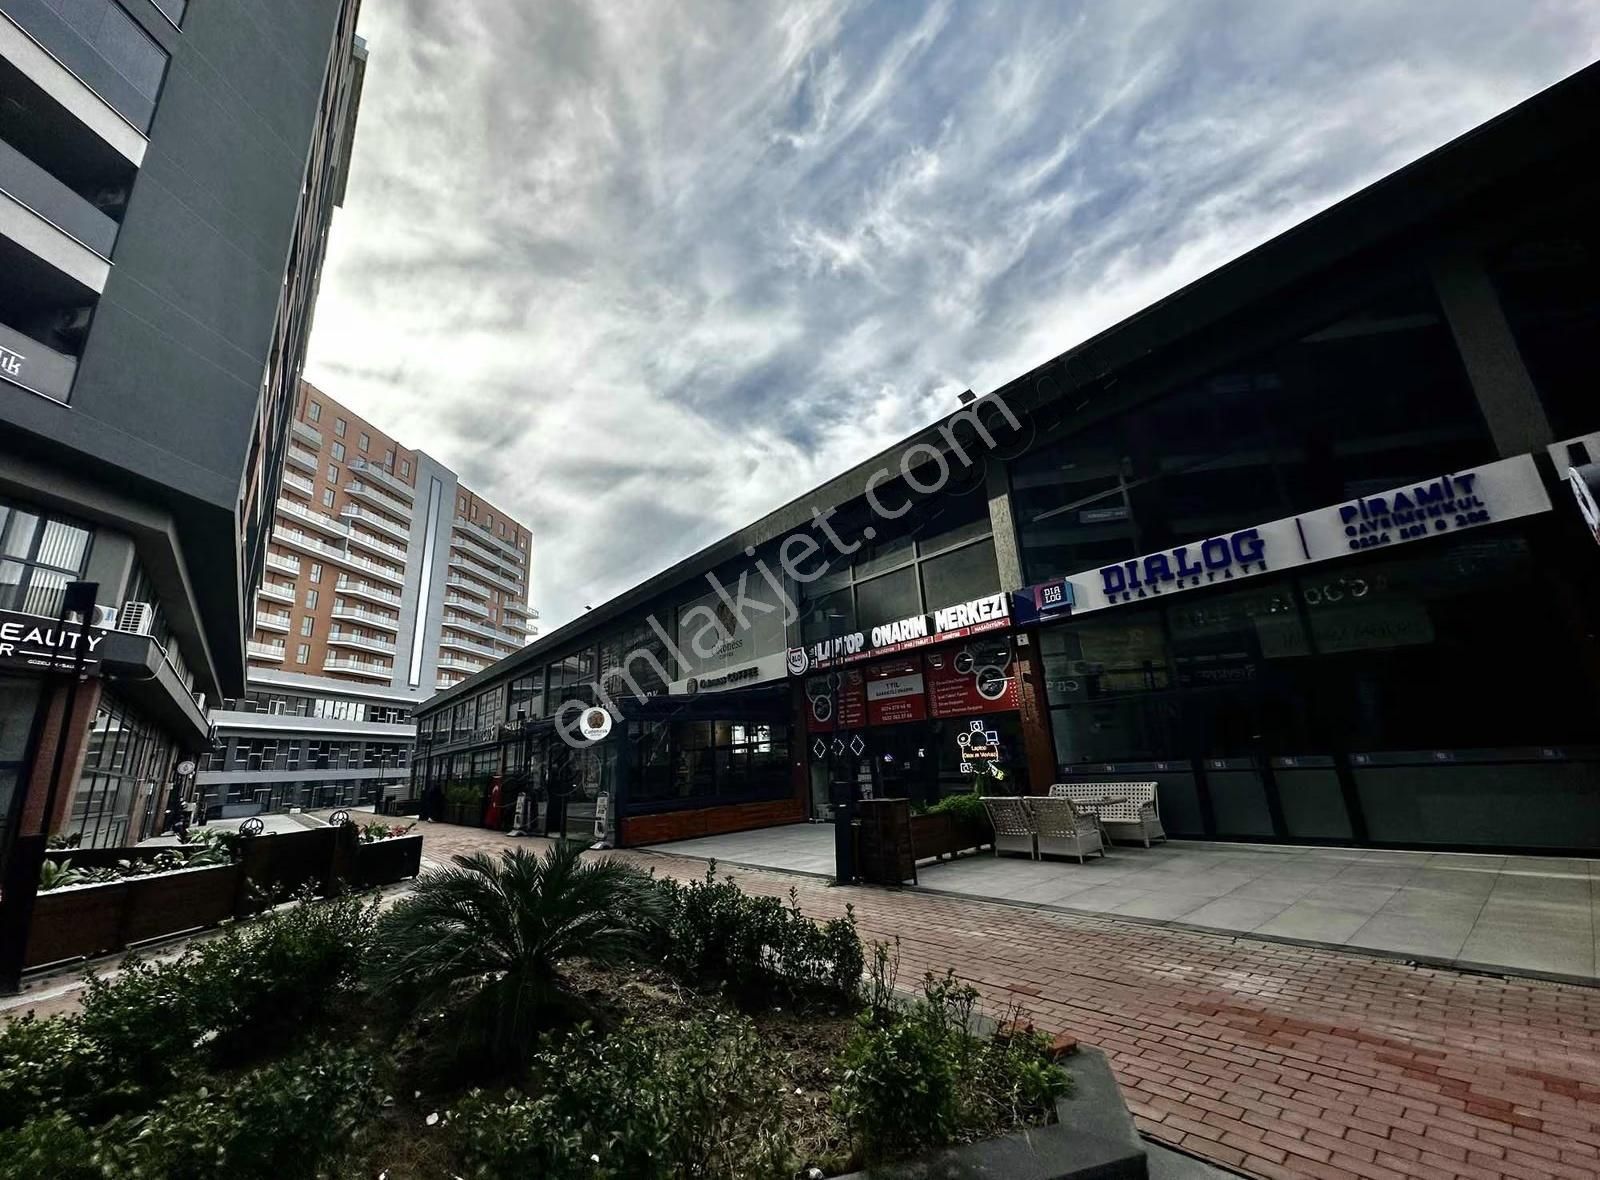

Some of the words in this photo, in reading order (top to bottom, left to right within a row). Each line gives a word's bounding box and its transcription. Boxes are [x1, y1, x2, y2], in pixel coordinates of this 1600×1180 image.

[1339, 472, 1476, 524] PİRAMİT
[1099, 529, 1265, 595] DIALOG
[1043, 585, 1061, 597] DIA
[1045, 593, 1062, 604] LOG
[1108, 584, 1161, 604] REAL
[1178, 561, 1268, 589] ESTATE
[871, 615, 928, 648] ONARIM
